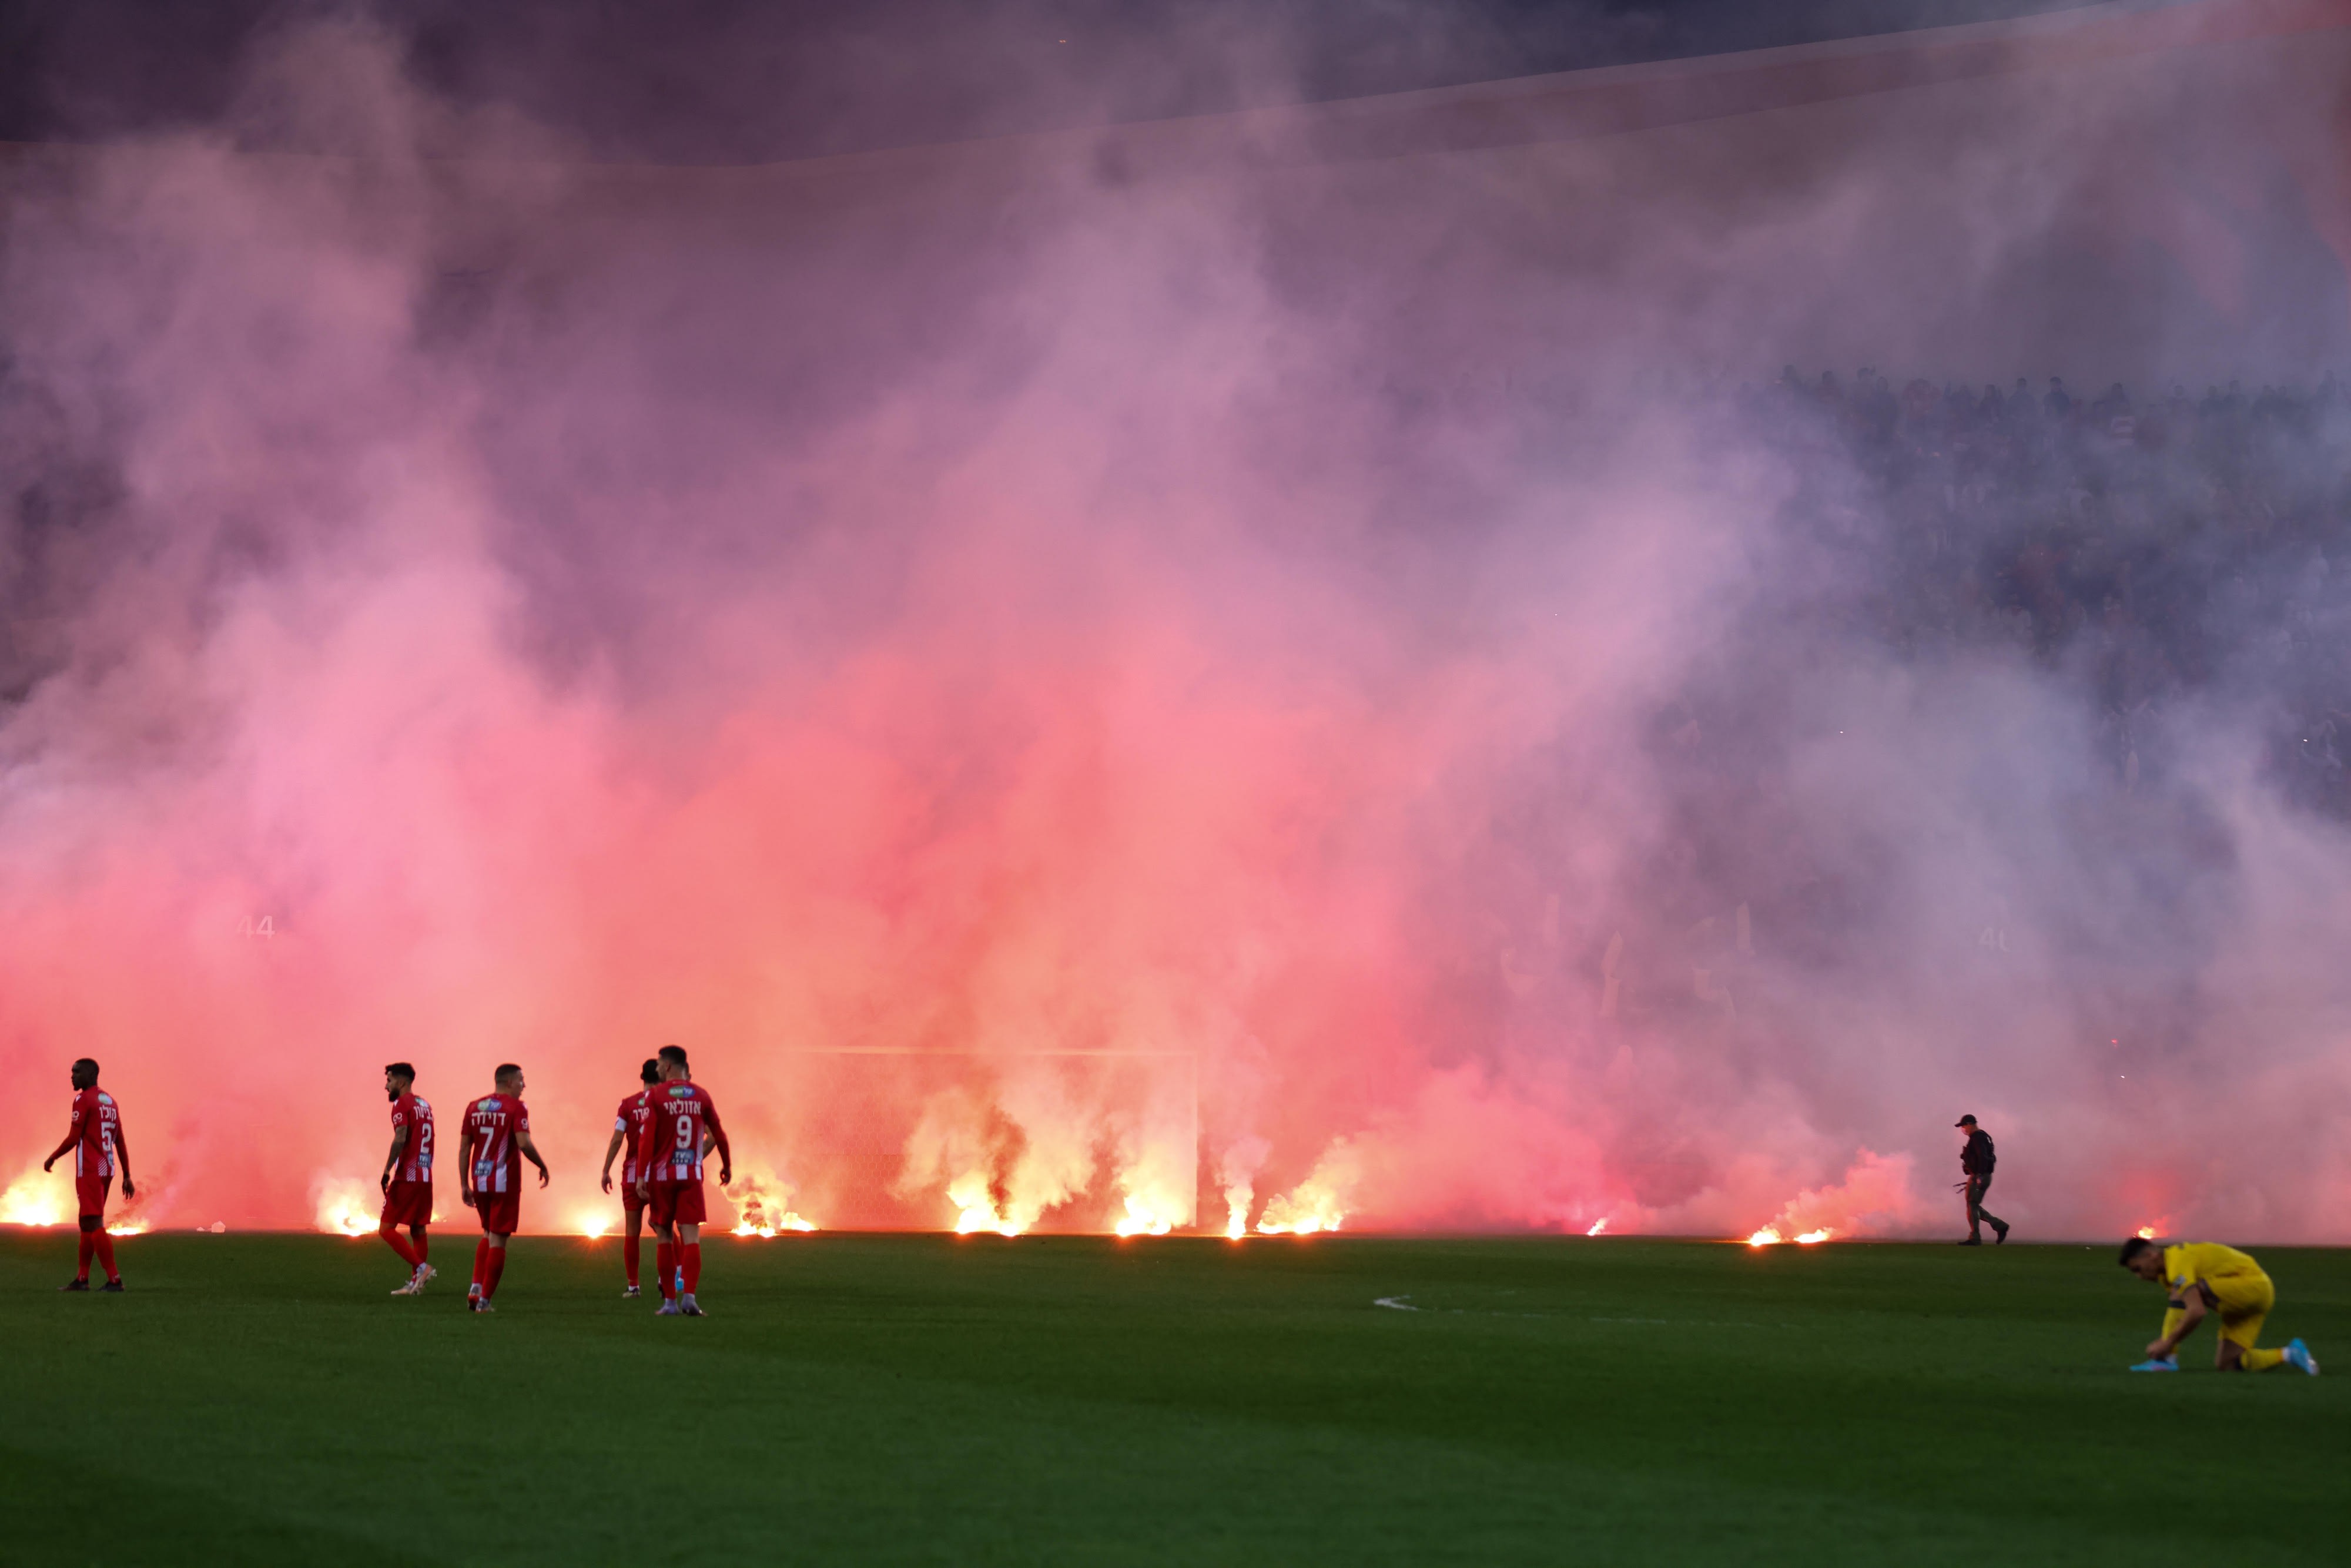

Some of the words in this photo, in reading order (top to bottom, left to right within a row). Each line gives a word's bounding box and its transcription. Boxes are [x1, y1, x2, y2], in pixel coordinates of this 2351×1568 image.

[236, 915, 276, 940] 44
[99, 1104, 116, 1122] קולו
[664, 1098, 702, 1115] אזולאי
[101, 1121, 116, 1151] 5
[420, 1123, 432, 1154] 2
[480, 1126, 494, 1160] 7
[677, 1114, 692, 1149] 9
